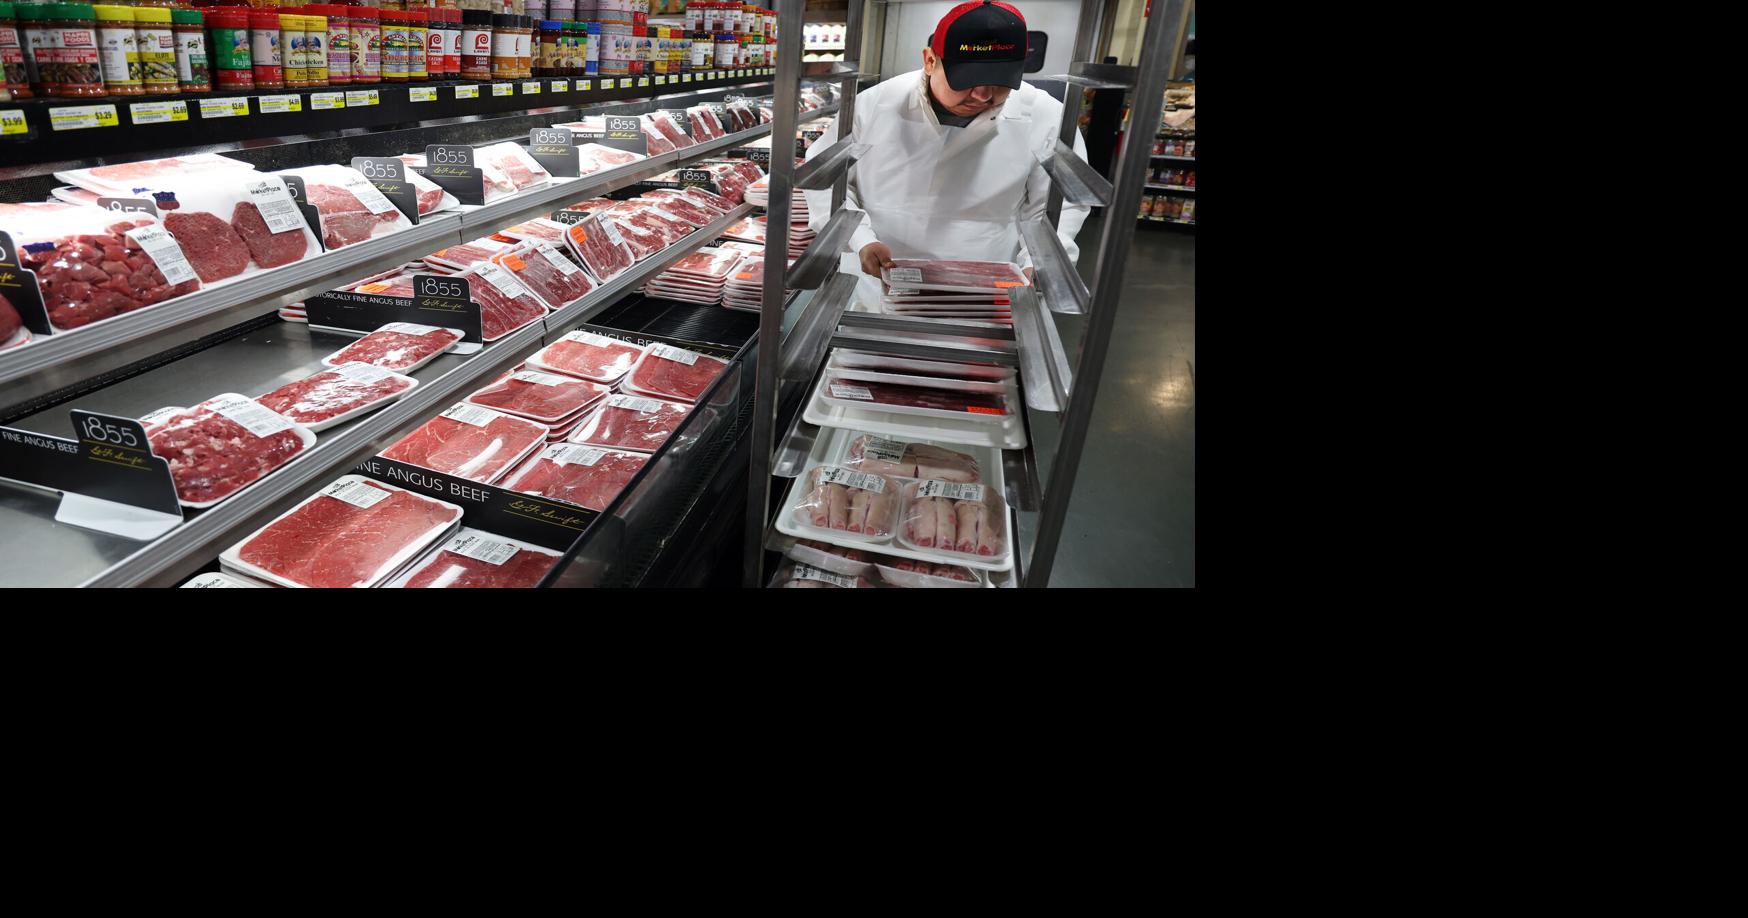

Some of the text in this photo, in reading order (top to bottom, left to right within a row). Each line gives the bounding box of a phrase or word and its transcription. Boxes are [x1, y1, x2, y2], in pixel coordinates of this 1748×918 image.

[610, 118, 636, 130] 1855
[535, 130, 566, 144] 1855
[433, 147, 467, 164] 1855
[360, 159, 397, 178] 1855
[683, 171, 707, 181] 1855
[421, 277, 462, 297] 1855
[353, 295, 368, 303] FINE
[369, 298, 394, 306] ANGUS
[82, 416, 137, 447] 1855
[2, 431, 79, 454] FINE ANGUS BEEF
[356, 459, 491, 503] INE ANGUS BEEF
